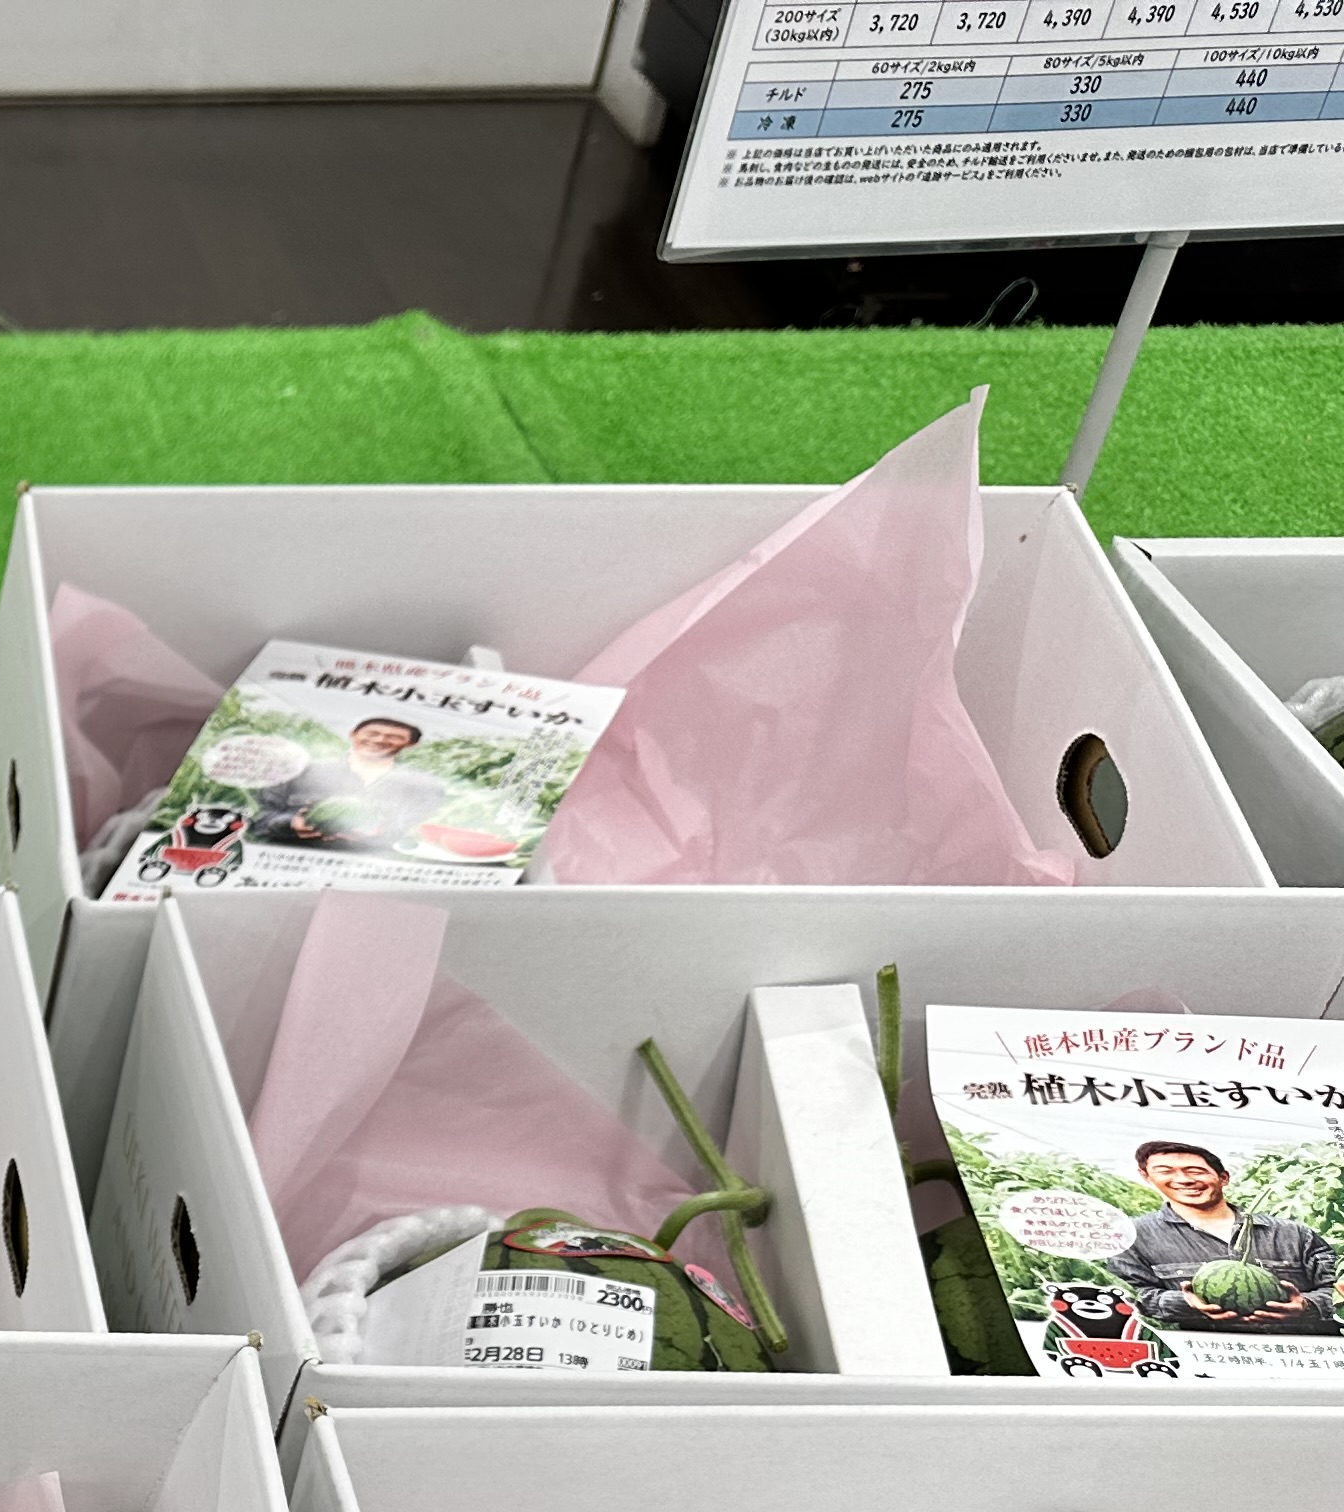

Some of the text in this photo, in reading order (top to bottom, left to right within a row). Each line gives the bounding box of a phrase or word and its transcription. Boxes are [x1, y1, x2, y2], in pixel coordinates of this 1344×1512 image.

[775, 0, 1344, 34] 200サイズ 3,720 3,720 4,390 4,390 4,530 4,530
[765, 28, 840, 43] (30kg以内)
[765, 68, 1269, 102] チルド 275 330 440
[890, 110, 925, 128] 275
[1060, 103, 1092, 123] 330
[1225, 97, 1258, 116] 440
[1023, 1026, 1286, 1070] 熊本県産ブランド品
[962, 1081, 1014, 1101] 完熟
